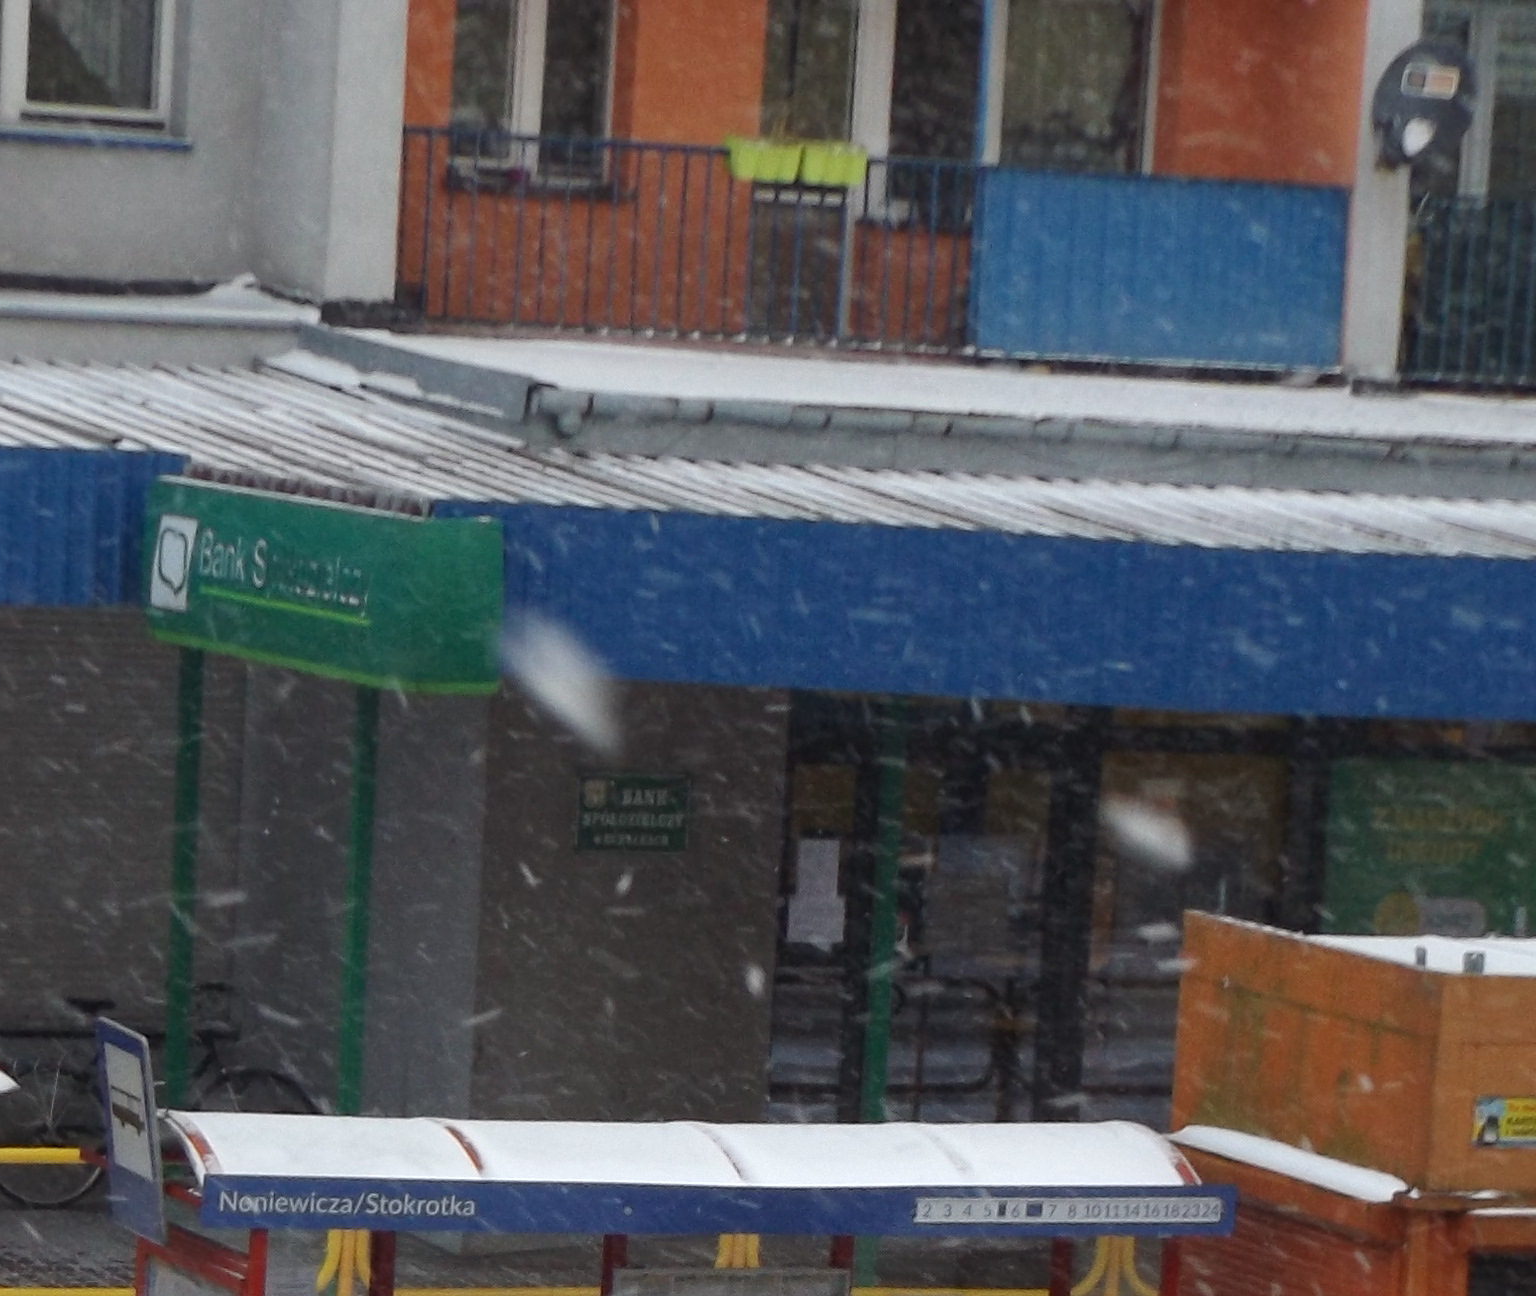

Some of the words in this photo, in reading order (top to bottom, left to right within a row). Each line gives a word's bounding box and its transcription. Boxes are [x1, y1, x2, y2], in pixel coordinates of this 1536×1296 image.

[199, 527, 246, 583] Bank
[621, 787, 669, 806] BANK
[218, 1189, 477, 1218] Noniewicza/Stokrotka
[923, 1203, 932, 1218] 2
[944, 1203, 952, 1217] 3
[963, 1203, 972, 1217] 4
[983, 1203, 992, 1217] 5
[1011, 1203, 1021, 1218] 6
[1047, 1203, 1058, 1218] 7
[1068, 1203, 1077, 1219] 8
[1085, 1203, 1102, 1218] 10
[1105, 1203, 1120, 1218] 11
[1124, 1203, 1141, 1218] 14
[1144, 1203, 1161, 1218] 16
